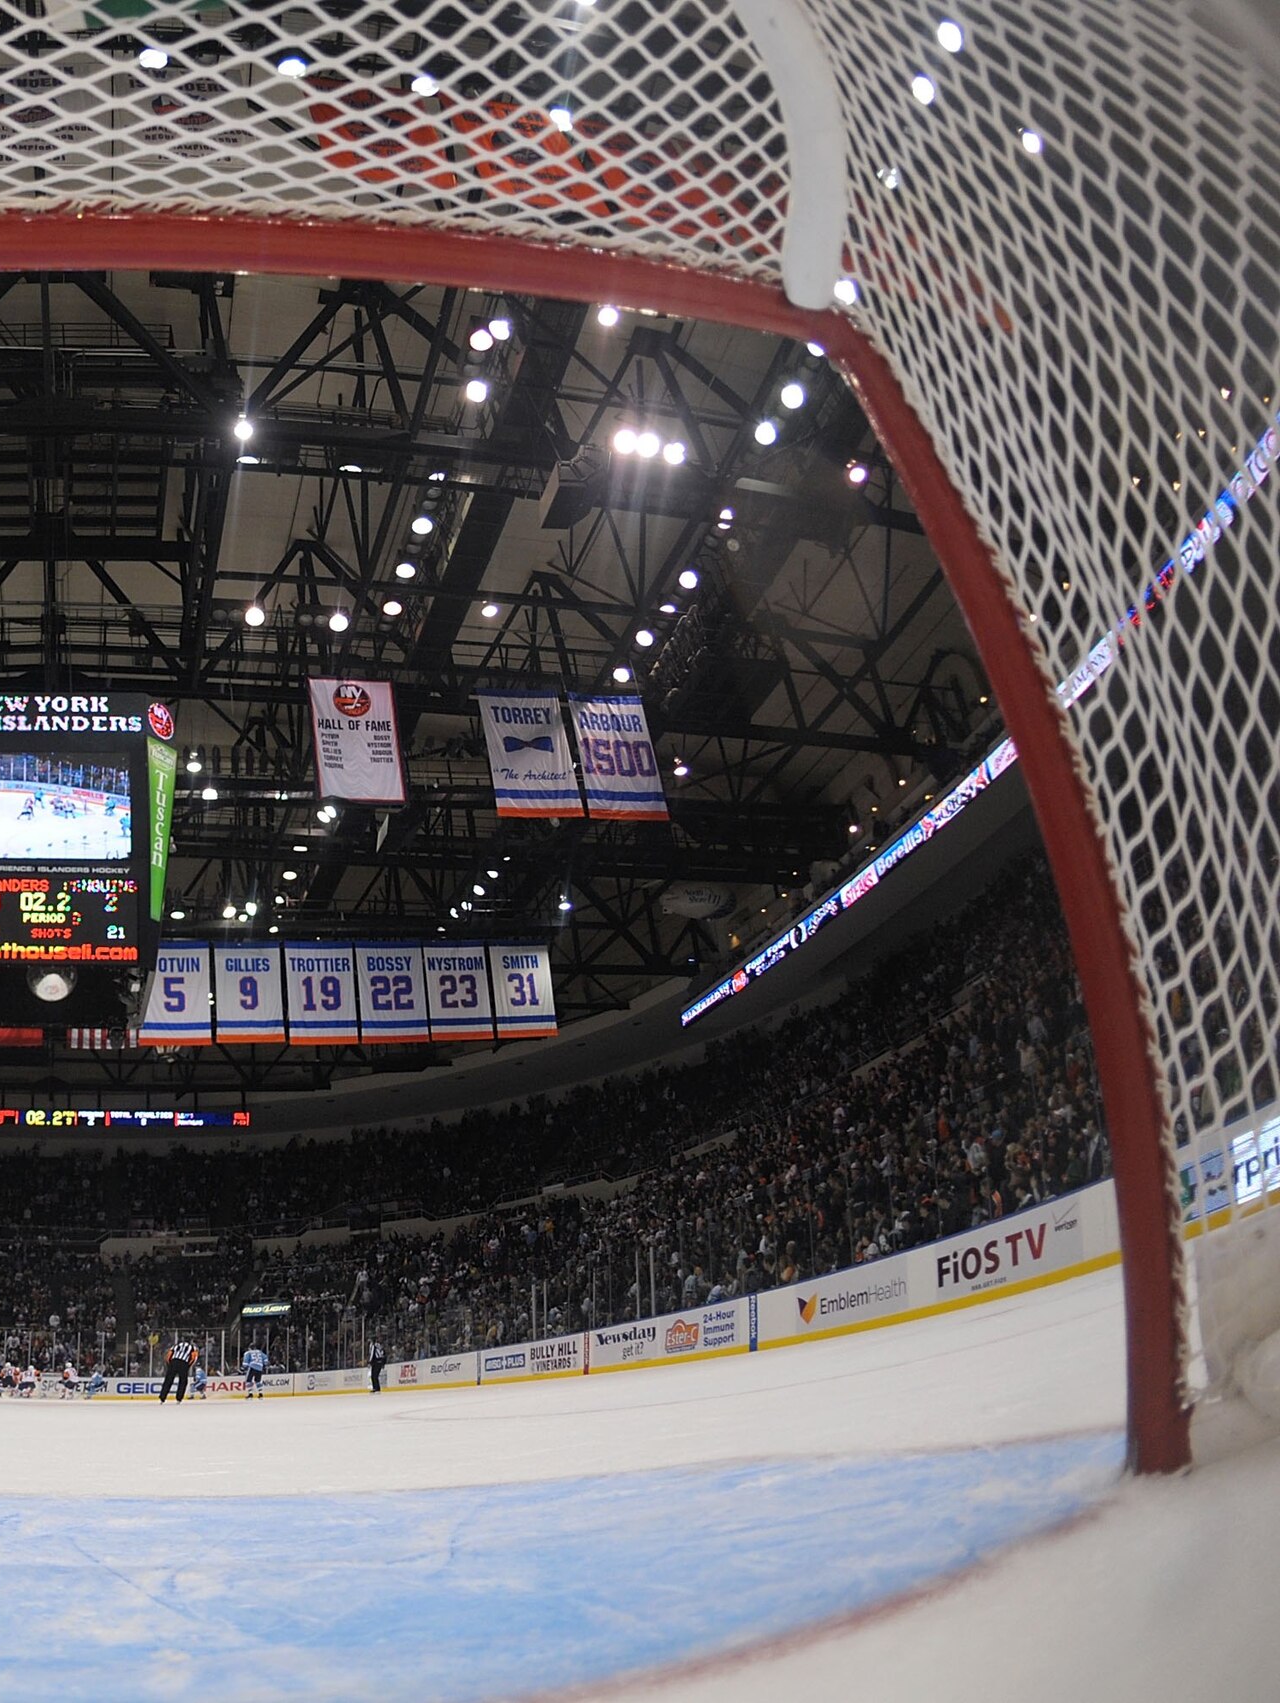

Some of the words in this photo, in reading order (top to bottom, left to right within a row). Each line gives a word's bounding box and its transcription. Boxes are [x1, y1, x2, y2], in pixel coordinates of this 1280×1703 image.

[34, 696, 109, 712] YORK
[491, 706, 551, 725] TORREY
[579, 711, 643, 733] ARBOUR
[318, 719, 343, 730] HALL
[348, 720, 360, 730] OF
[365, 720, 392, 731] FAME
[580, 737, 656, 778] 1500
[151, 769, 168, 869] Tuscan
[37, 866, 90, 874] ISLANDERS
[91, 866, 131, 875] HOCKEY
[22, 912, 66, 924] PERIOD
[30, 928, 72, 939] SHOTS
[106, 925, 125, 939] 21
[158, 956, 200, 973] OTVIN
[225, 957, 270, 973] GILLIES
[289, 957, 351, 973] TROTTIER
[366, 956, 412, 972] BOSSY
[428, 956, 484, 971] NYSTROM
[502, 954, 539, 970] SMITH
[163, 977, 186, 1013] 5
[239, 976, 258, 1010] 9
[302, 976, 341, 1012] 19
[370, 975, 415, 1011] 22
[440, 974, 478, 1009] 23
[508, 973, 540, 1008] 31
[937, 1240, 1001, 1288] FiOS
[1005, 1222, 1047, 1267] TV
[820, 1276, 907, 1314] EmblemHealth
[242, 1306, 262, 1314] BUD
[265, 1304, 291, 1312] LIGHT
[703, 1310, 735, 1323] 24-Hour
[667, 1325, 697, 1347] Ester-C
[703, 1321, 735, 1335] Immune
[595, 1326, 657, 1347] Newsday
[703, 1334, 735, 1348] Support
[530, 1344, 556, 1360] BULLY
[558, 1341, 578, 1355] HILL
[622, 1346, 634, 1360] get
[506, 1355, 525, 1367] PLUS
[536, 1357, 572, 1372] VINEYARDS
